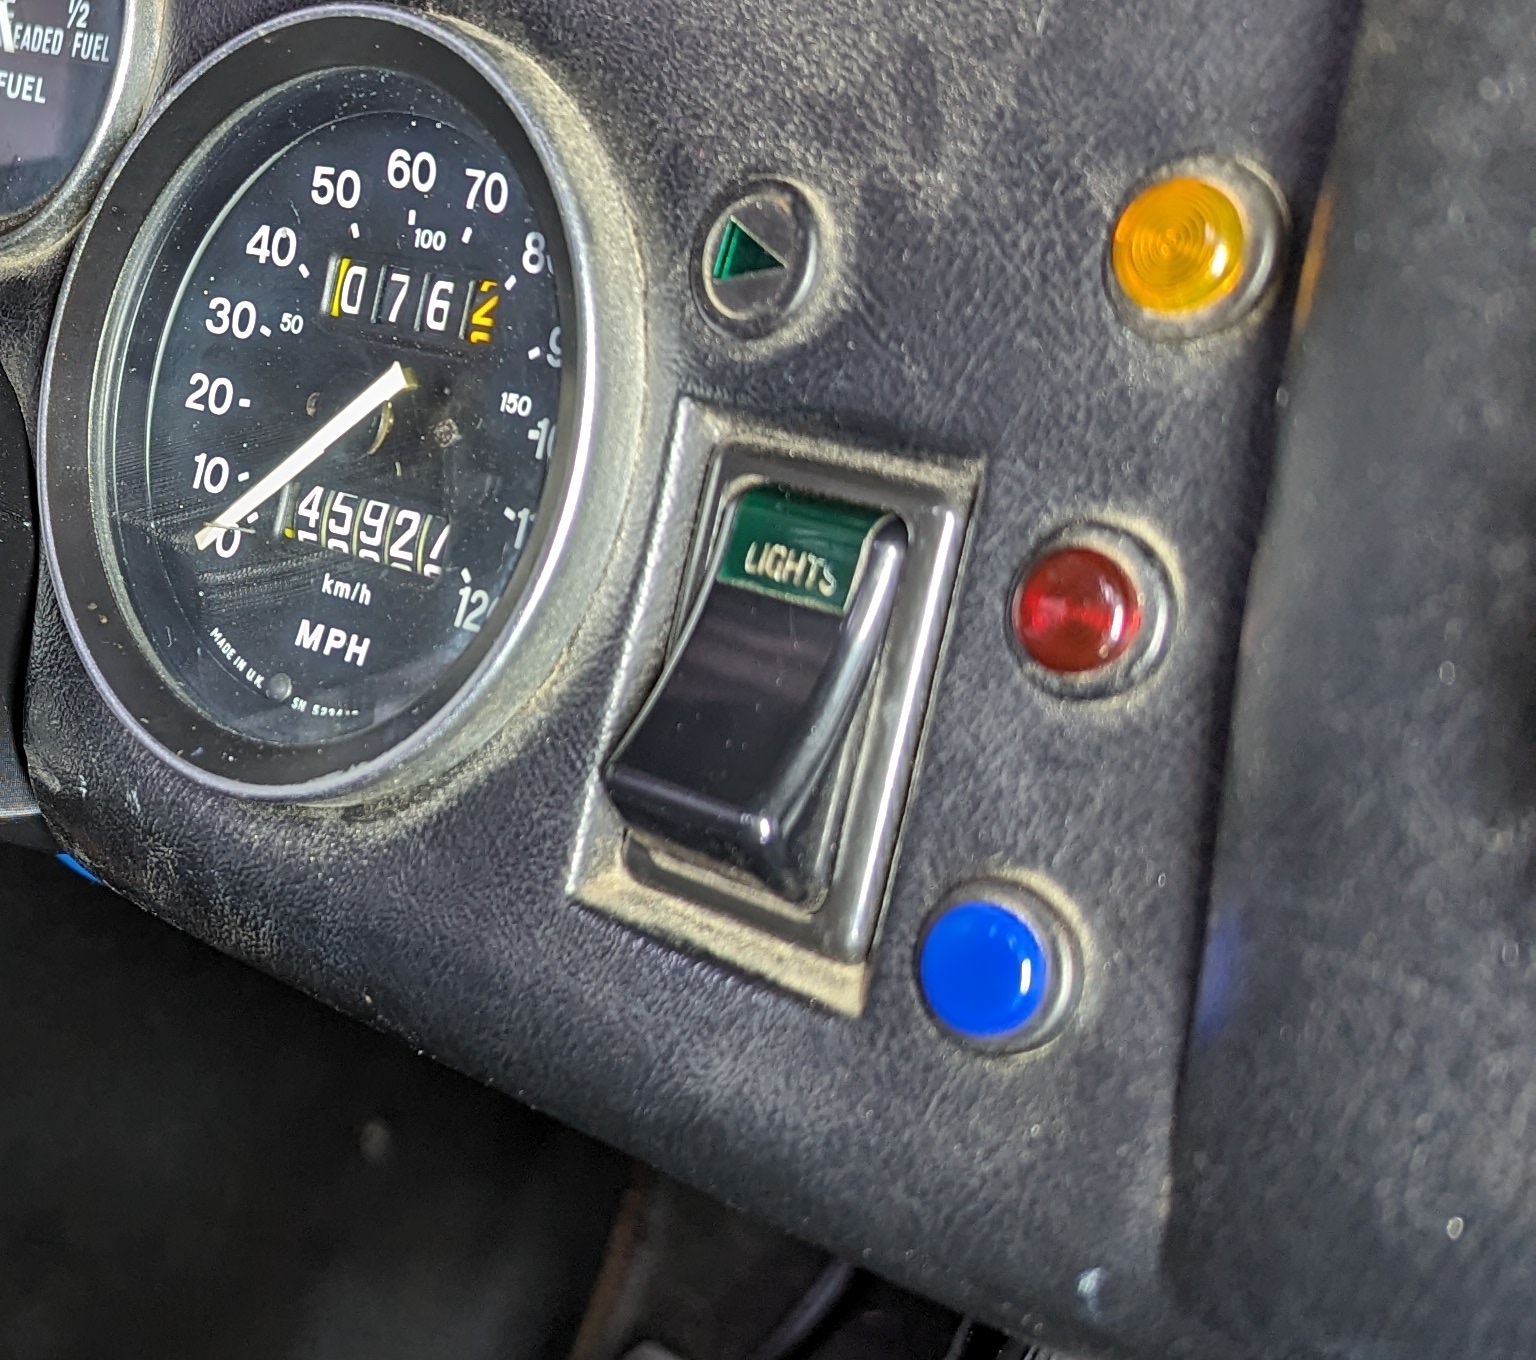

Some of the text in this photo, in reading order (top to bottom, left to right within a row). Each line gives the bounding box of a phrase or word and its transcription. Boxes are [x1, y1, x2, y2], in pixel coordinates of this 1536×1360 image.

[71, 30, 110, 63] FUEL
[310, 165, 361, 209] 50
[387, 148, 437, 192] 60
[465, 167, 509, 214] 70
[245, 224, 297, 267] 40
[414, 228, 447, 251] 100
[522, 231, 554, 275] 8
[205, 296, 257, 340] 30
[279, 312, 304, 334] 50
[185, 372, 234, 416] 20
[499, 391, 533, 418] 150
[192, 452, 230, 494] 10
[215, 523, 242, 559] 0
[321, 572, 372, 606] km/h
[745, 541, 837, 597] LIGHTS
[453, 586, 500, 633] 12
[210, 627, 265, 689] MADE IN UK
[294, 618, 371, 667] MPH
